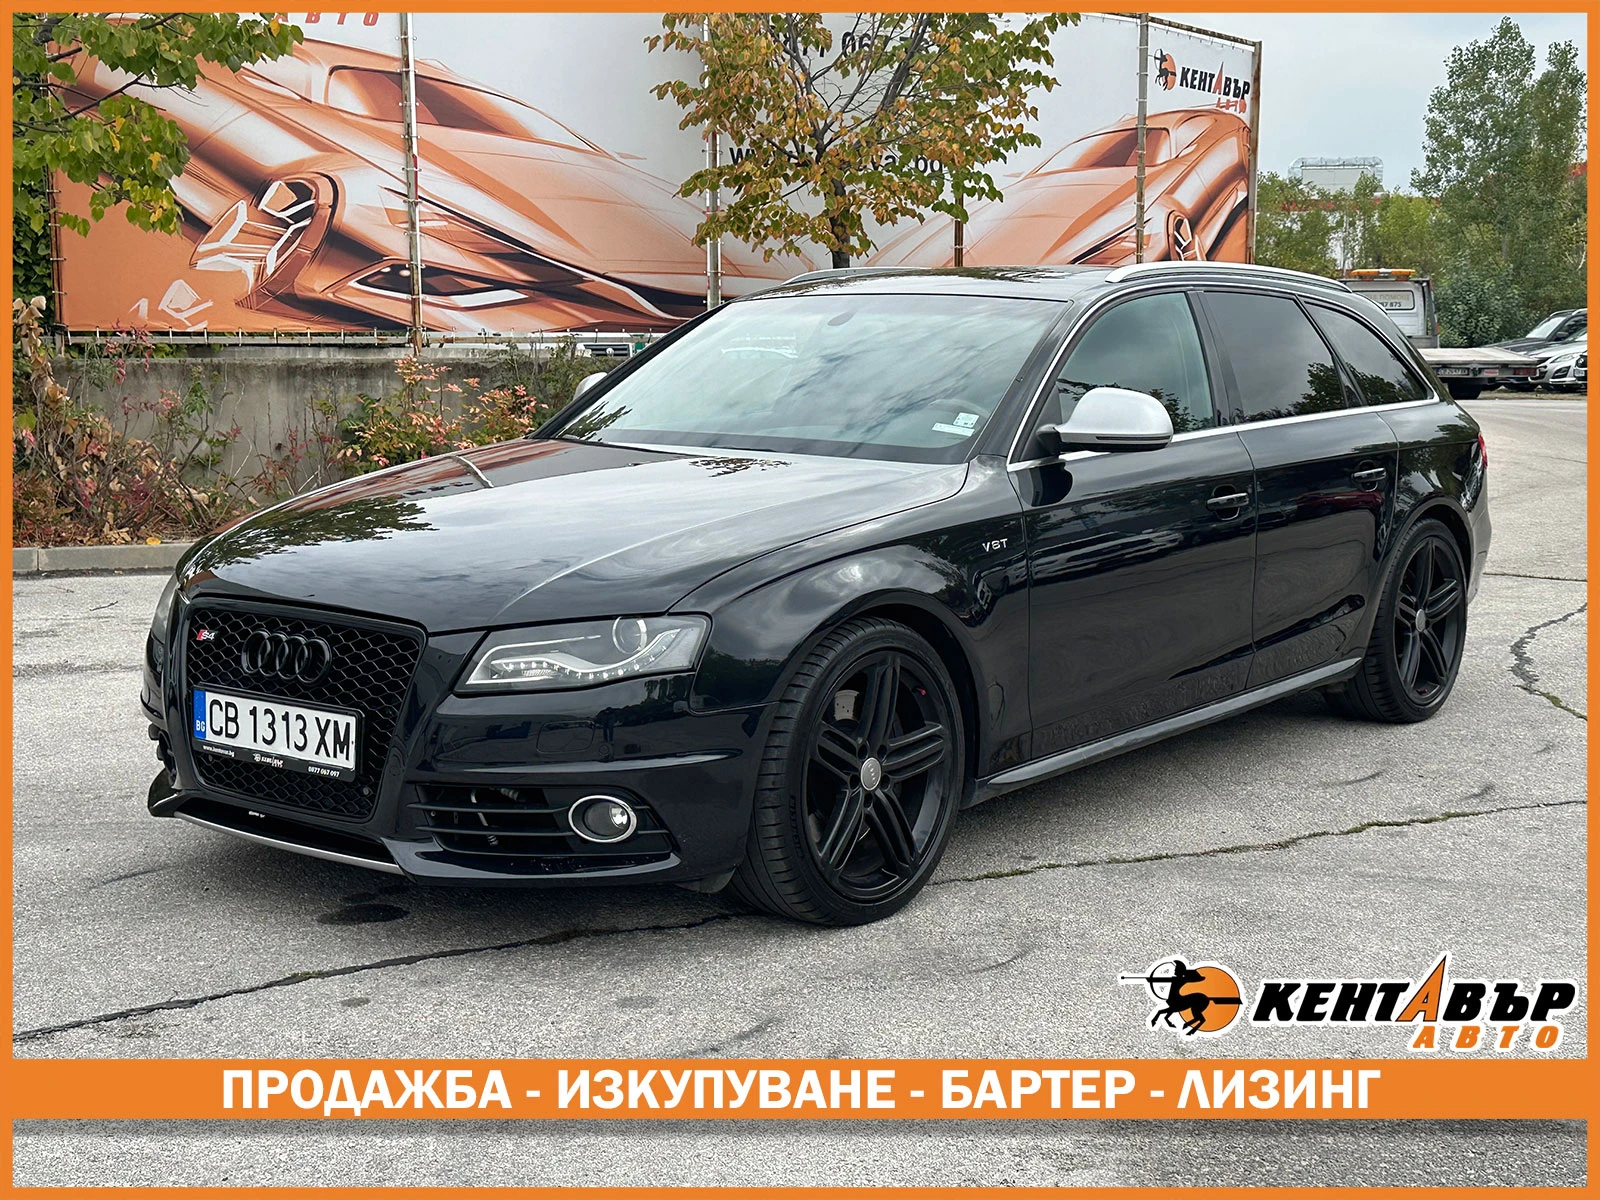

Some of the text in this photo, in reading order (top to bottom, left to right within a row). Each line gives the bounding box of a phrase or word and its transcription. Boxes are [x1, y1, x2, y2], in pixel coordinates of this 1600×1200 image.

[1179, 61, 1250, 100] КЕНТАВЪР
[200, 630, 215, 640] S4
[196, 719, 205, 731] BG
[209, 699, 351, 761] CB 1313 XM
